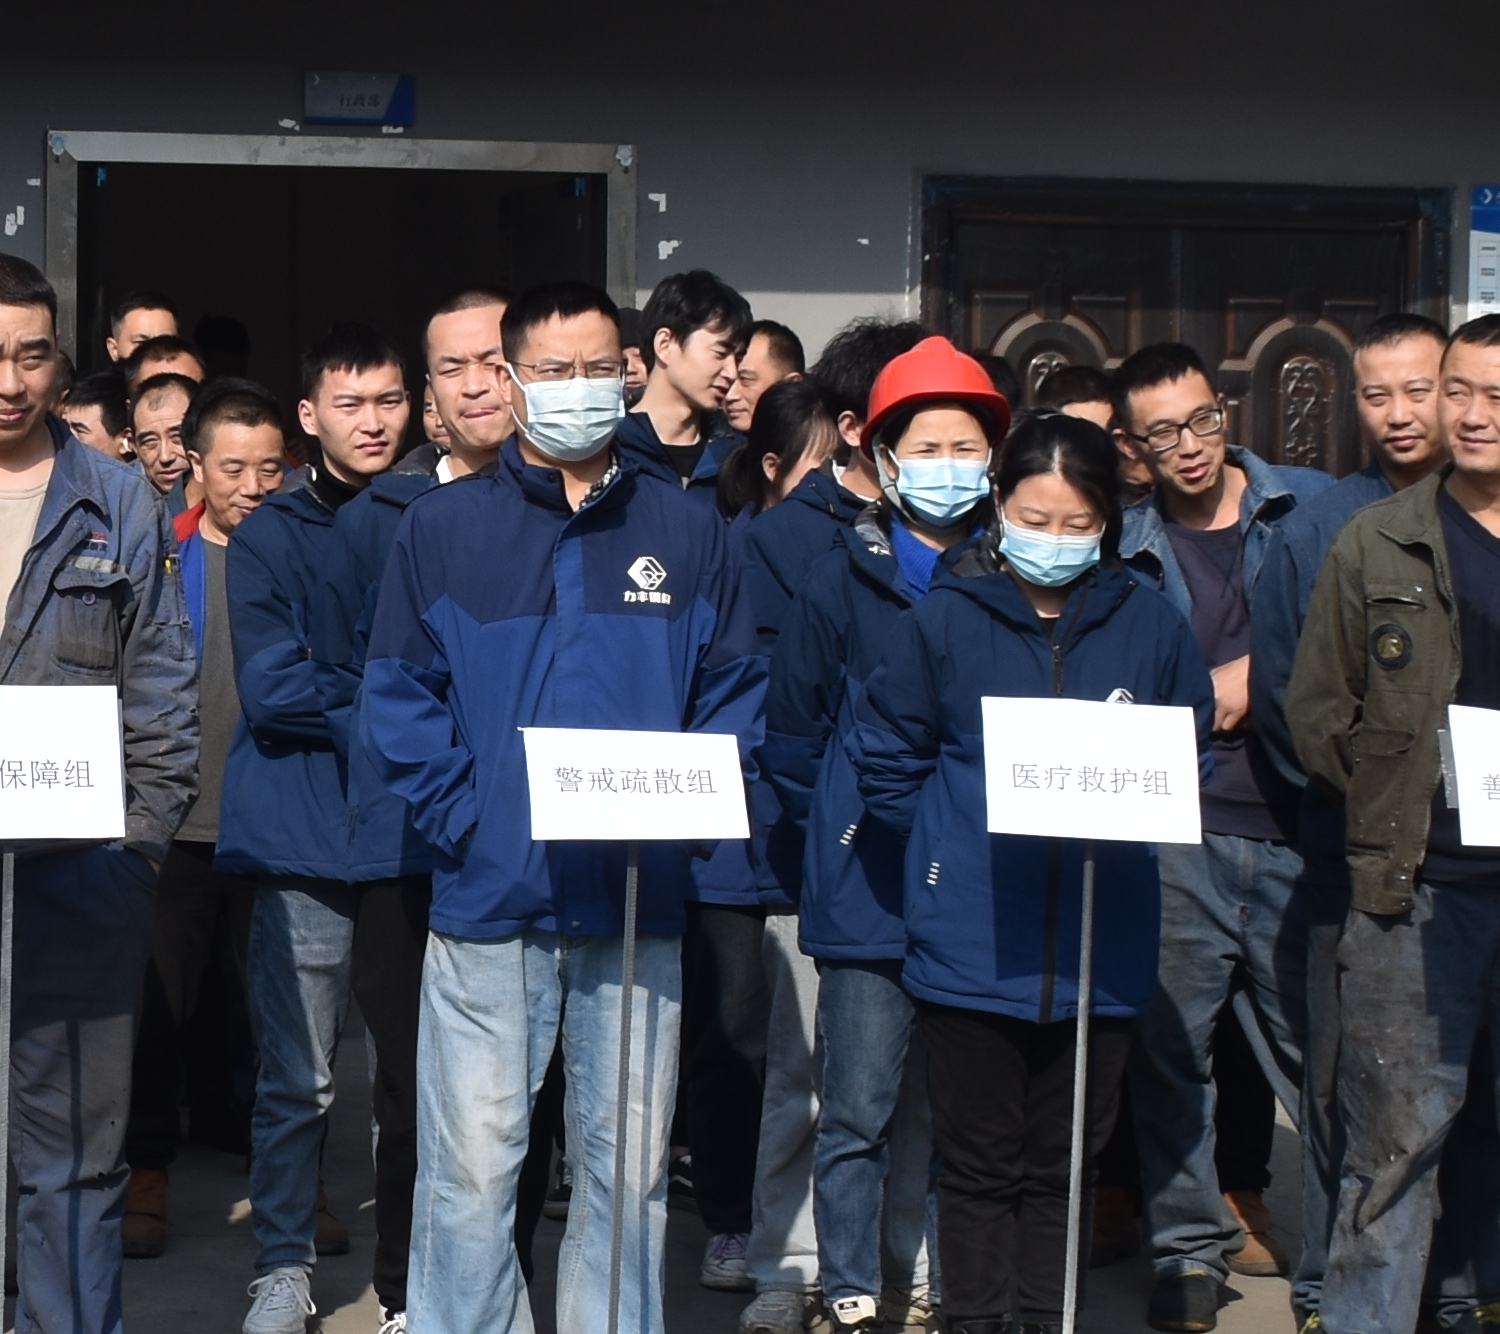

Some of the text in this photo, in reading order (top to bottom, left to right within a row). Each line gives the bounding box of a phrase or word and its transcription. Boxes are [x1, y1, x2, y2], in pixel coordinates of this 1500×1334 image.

[553, 766, 718, 795] 警戒疏散组
[1012, 763, 1173, 796] 医疗救护组
